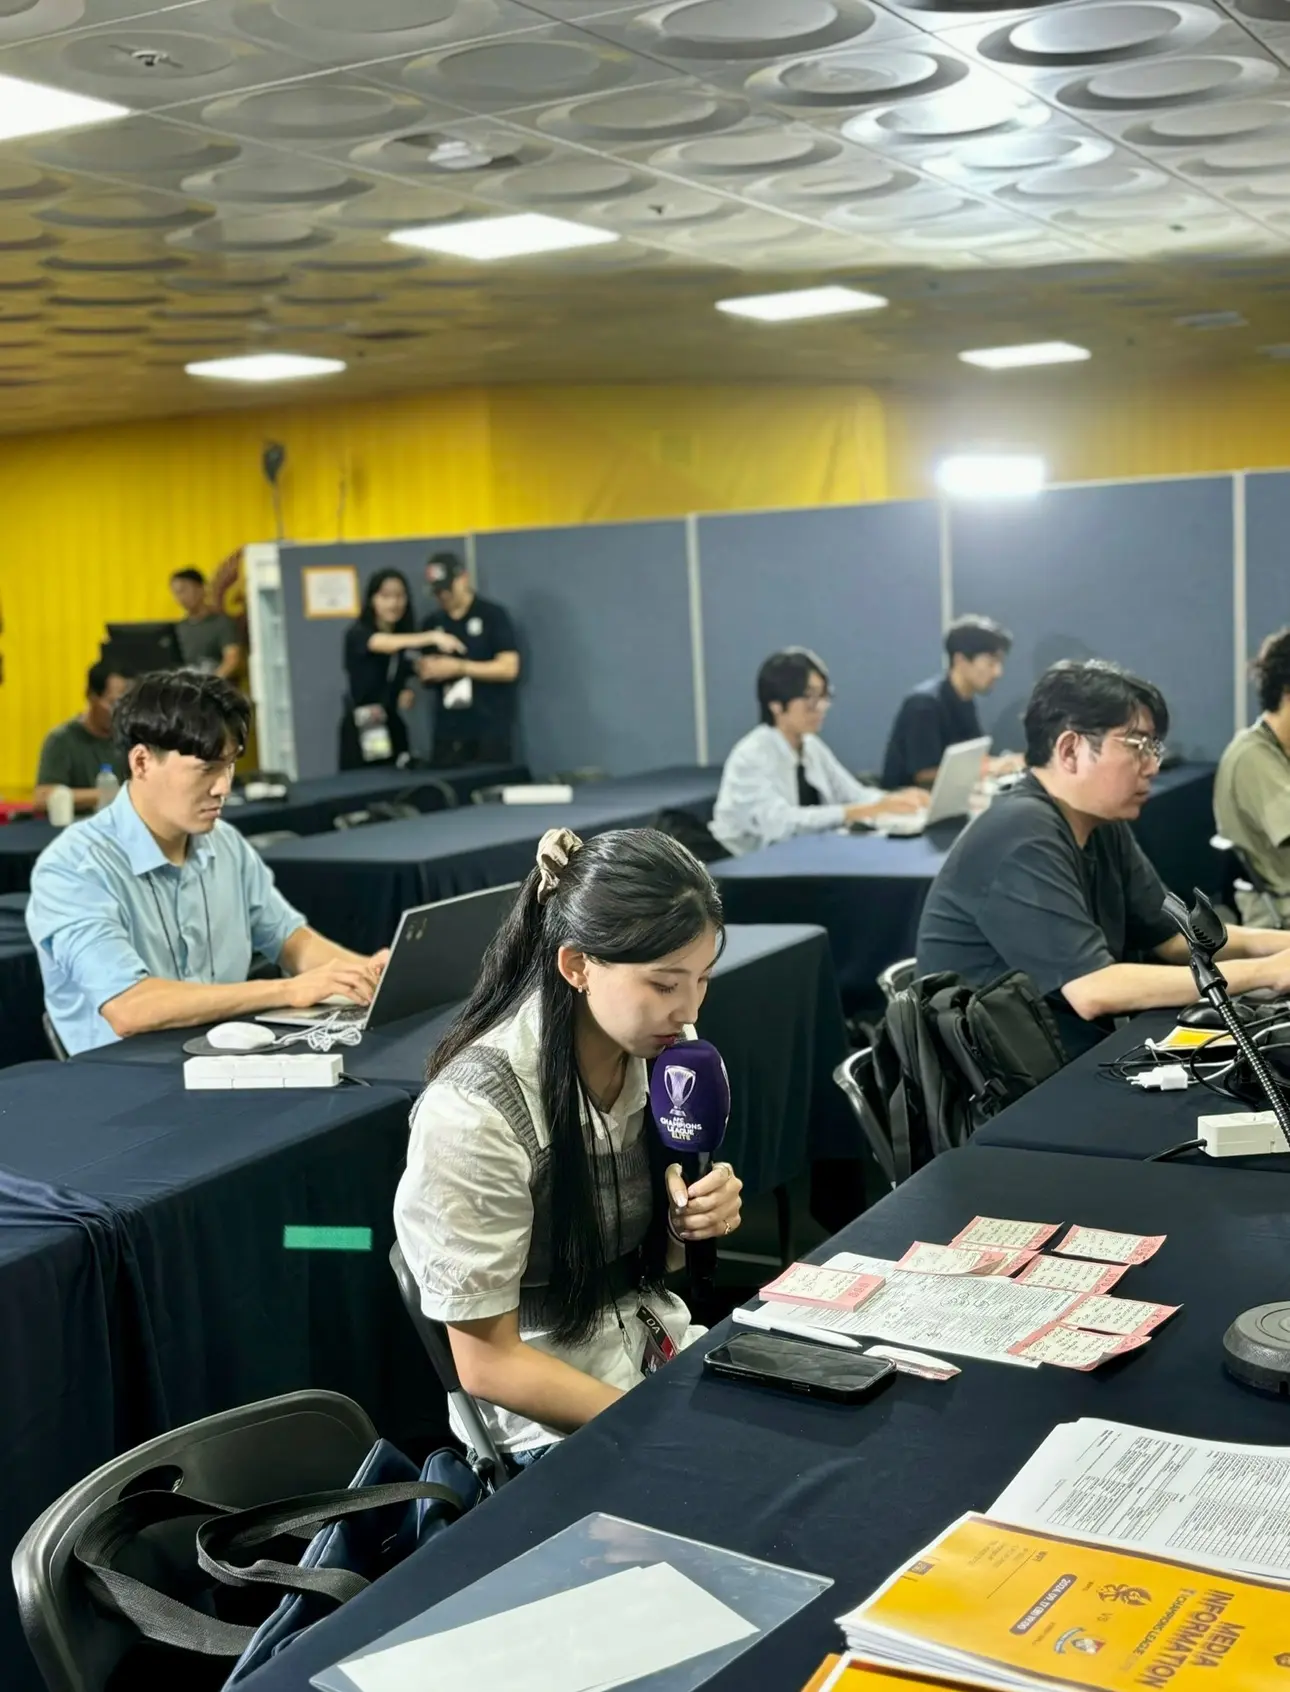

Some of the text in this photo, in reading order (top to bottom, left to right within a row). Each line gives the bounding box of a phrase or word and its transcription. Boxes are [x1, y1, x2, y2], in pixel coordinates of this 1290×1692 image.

[660, 1117, 702, 1130] CHAMPIONS
[667, 1125, 694, 1135] LEAGUE
[672, 1131, 691, 1140] ELITE
[1133, 1596, 1188, 1656] CHAMPIONS LEAGUE
[1135, 1589, 1235, 1689] INFORMATION
[1189, 1621, 1246, 1668] MEDIA
